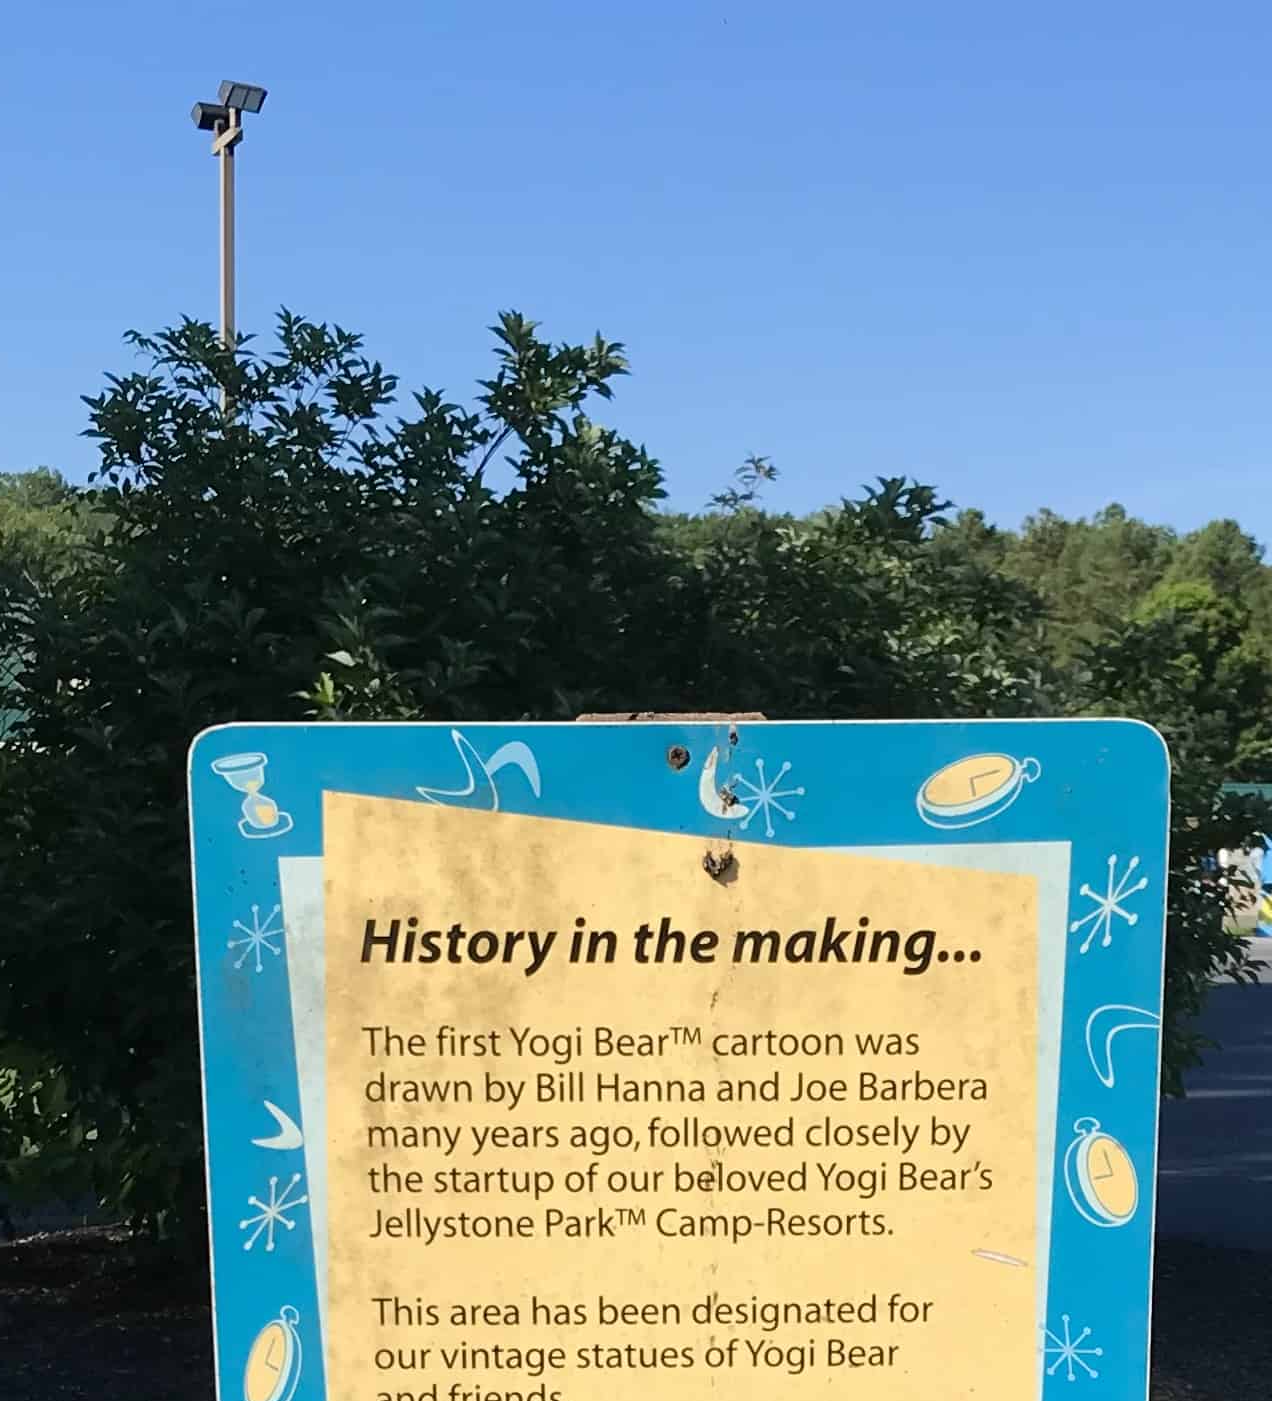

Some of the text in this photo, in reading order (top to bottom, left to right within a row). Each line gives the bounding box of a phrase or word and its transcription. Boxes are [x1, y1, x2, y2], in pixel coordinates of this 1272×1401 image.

[359, 915, 982, 979] History in the making...
[361, 1025, 427, 1057] The
[435, 1024, 502, 1057] first
[508, 1026, 582, 1066] Yogi
[711, 1029, 844, 1057] cartoon
[854, 1032, 920, 1056] was
[364, 1069, 988, 1112] drawn by Bill Hanna and Joe Barbera
[367, 1115, 971, 1157] many years ago, followed closely by
[367, 1162, 424, 1194] the
[433, 1167, 555, 1201] startup
[564, 1161, 600, 1193] of
[607, 1170, 665, 1193] our
[674, 1159, 807, 1193] beloved
[815, 1161, 887, 1200] Yogi
[369, 1207, 535, 1247] Jellystone
[655, 1207, 894, 1245] Camp-Resorts.
[370, 1291, 934, 1333] This area has been designated for
[374, 1338, 900, 1377] our vintage statues of Yogi Bear
